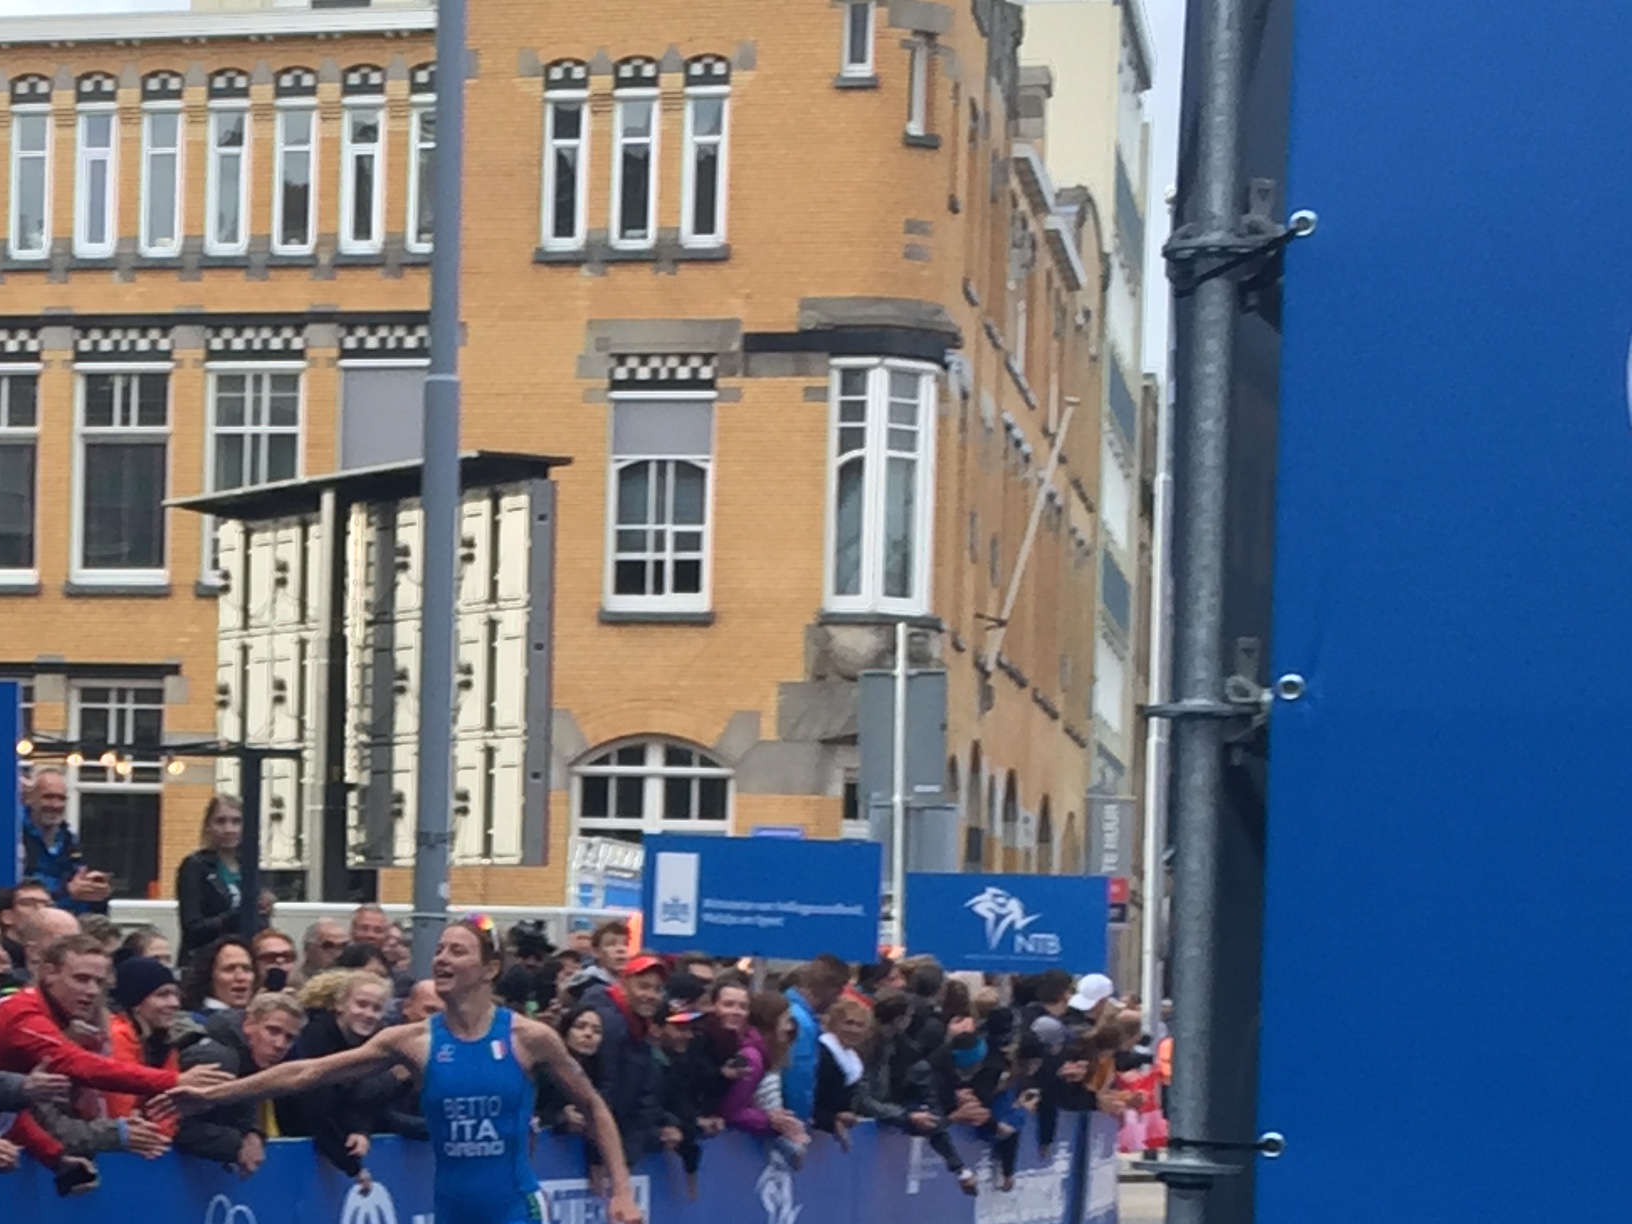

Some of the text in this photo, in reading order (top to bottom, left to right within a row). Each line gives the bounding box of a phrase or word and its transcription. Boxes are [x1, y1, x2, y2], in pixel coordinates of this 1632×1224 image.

[1014, 933, 1062, 955] NTB
[443, 1095, 502, 1119] BETTO
[450, 1119, 499, 1141] ITA
